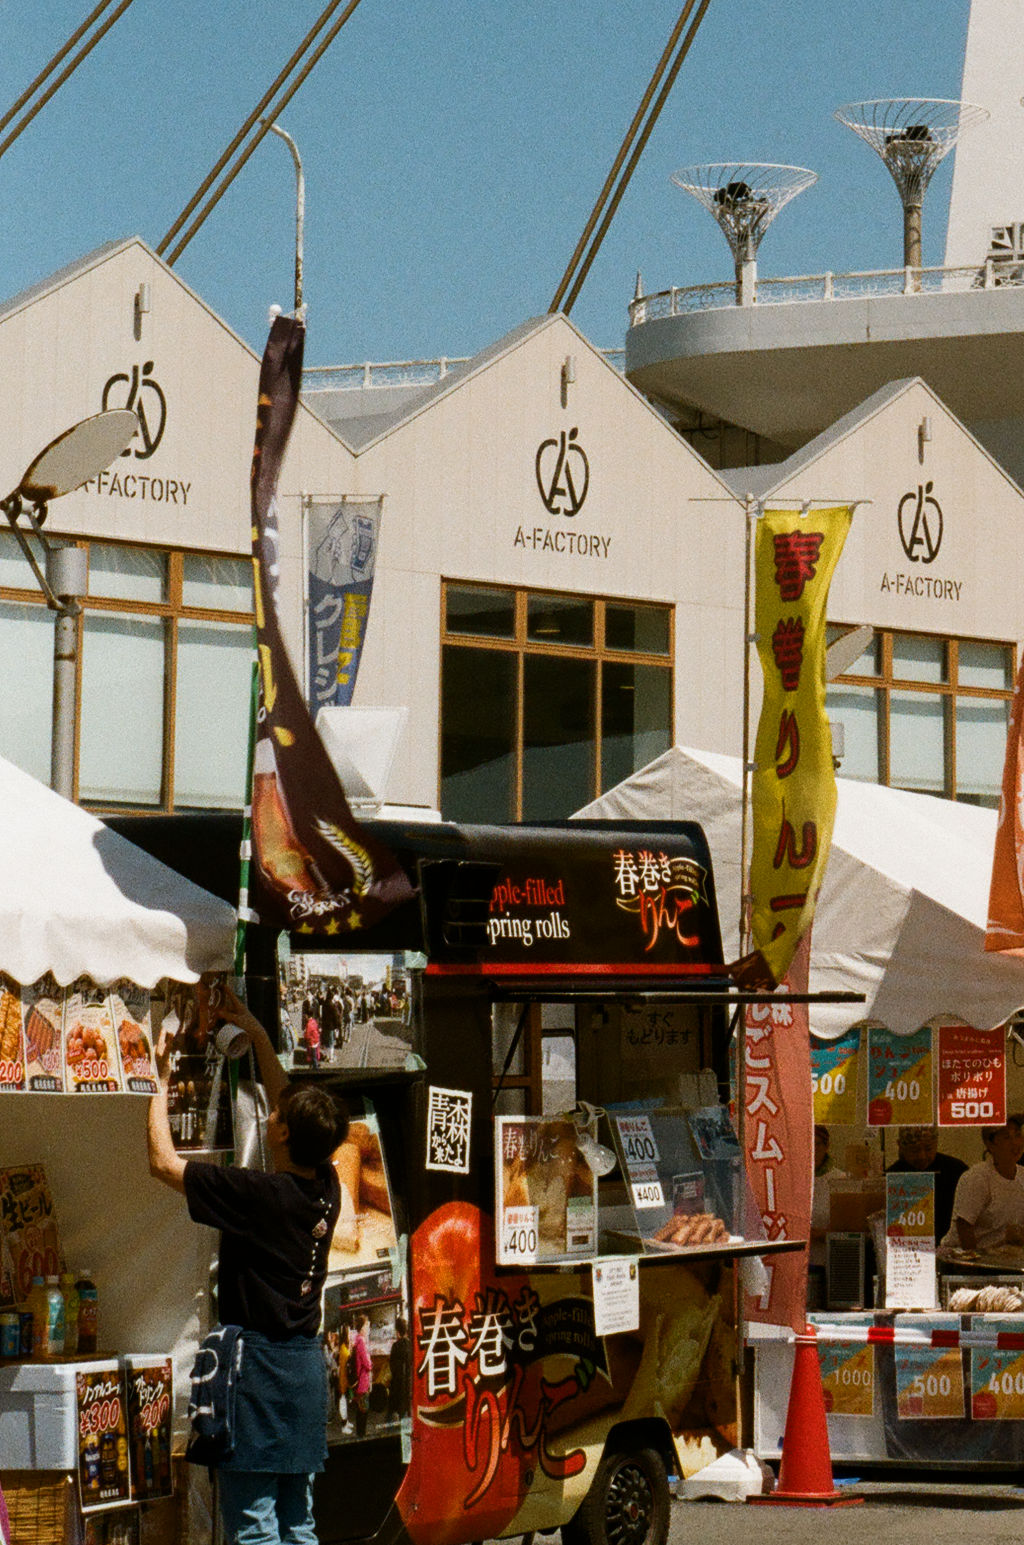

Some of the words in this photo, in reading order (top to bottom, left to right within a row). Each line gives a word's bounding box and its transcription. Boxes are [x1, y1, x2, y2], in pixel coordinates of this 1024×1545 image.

[513, 525, 612, 559] A-FACTORY
[880, 571, 963, 602] A-FACTORY
[612, 848, 672, 896] 春巻き
[488, 877, 566, 912] pple-filled
[535, 911, 571, 939] rolls
[626, 1027, 693, 1046] もどります
[76, 1059, 109, 1080] ¥500
[941, 1057, 1003, 1070] ほたてのひも
[811, 1072, 847, 1095] 500
[884, 1079, 921, 1101] 400
[431, 1092, 469, 1146] 青森
[950, 1101, 994, 1119] 500
[636, 1185, 661, 1203] ¥400
[2, 1191, 53, 1233] 生ビール
[897, 1209, 927, 1227] 400
[503, 1228, 538, 1255] ¥400
[417, 1286, 540, 1398] 春巻き
[833, 1368, 873, 1386] 1000
[912, 1374, 952, 1397] 500
[79, 1396, 121, 1439] ¥300
